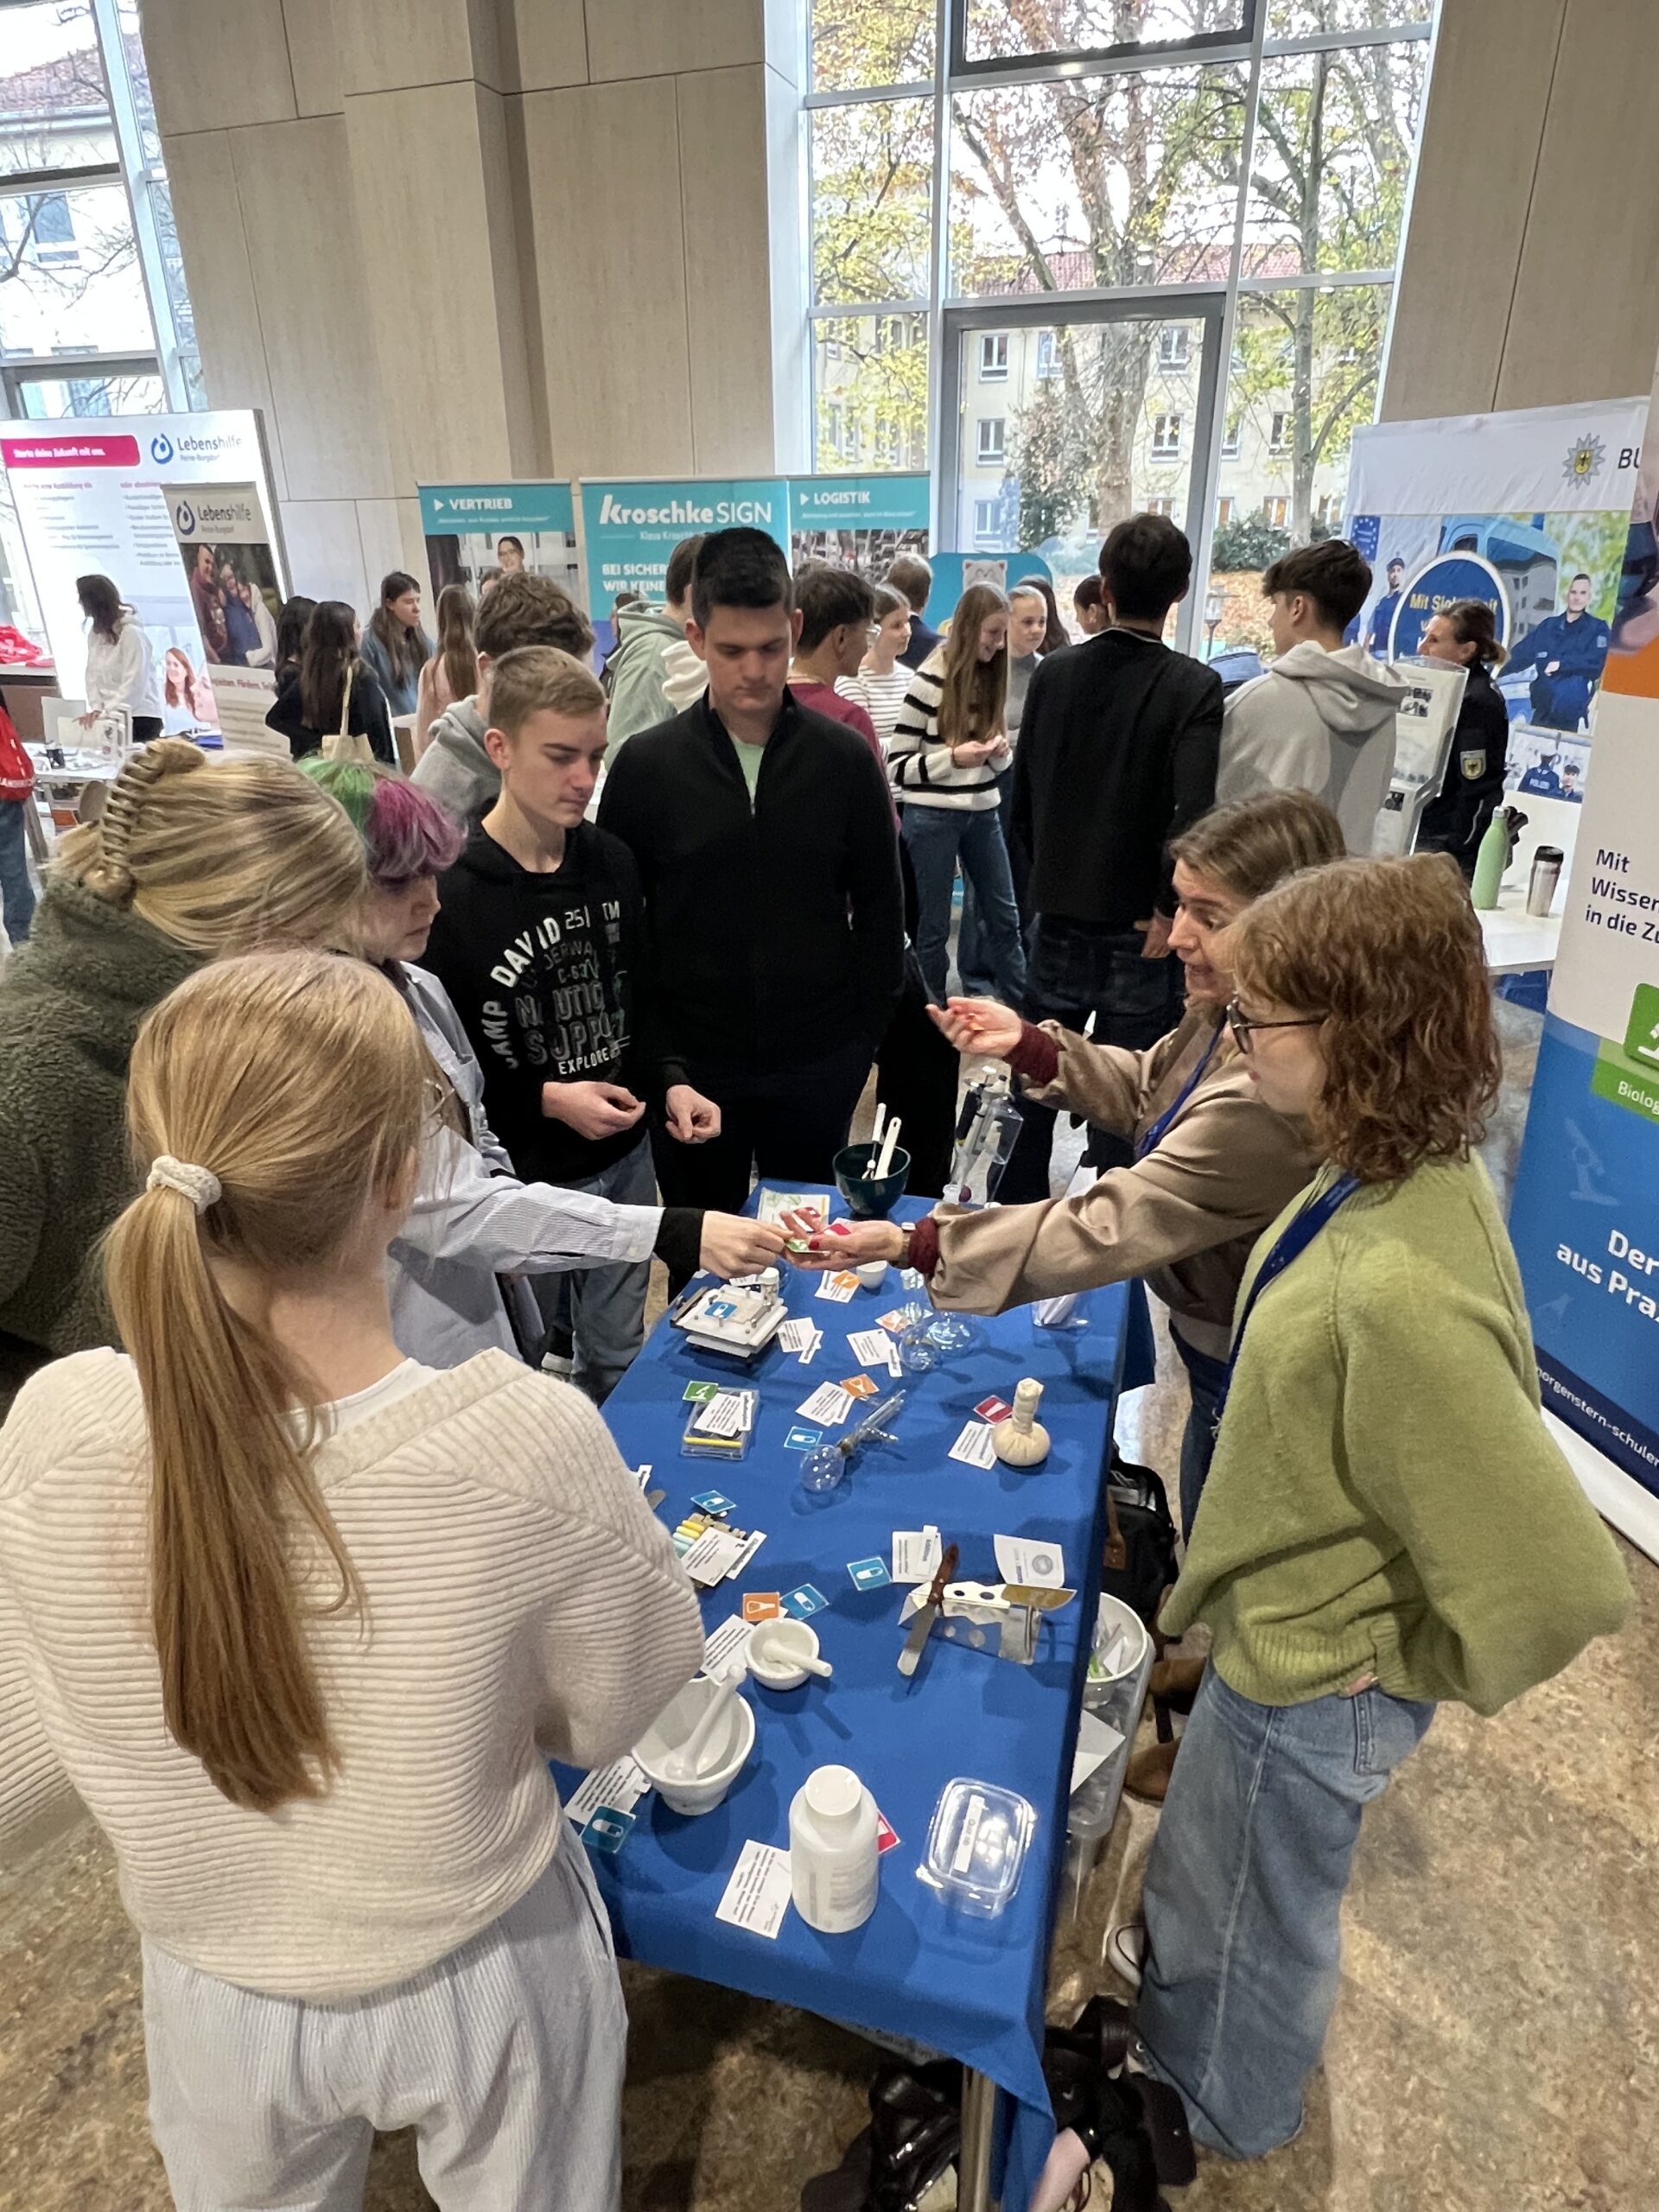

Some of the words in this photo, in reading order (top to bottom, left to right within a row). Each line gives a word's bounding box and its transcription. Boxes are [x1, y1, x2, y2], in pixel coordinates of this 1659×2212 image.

[177, 435, 242, 451] Lebenshilfe
[448, 498, 512, 511] VERTRIEB
[814, 491, 871, 505] LOGISTIK
[197, 504, 251, 521] Lebenshilfe
[602, 563, 620, 576] BEI
[603, 581, 627, 592] WIR
[1409, 594, 1429, 610] Mit
[1596, 849, 1630, 874] Mit
[1585, 904, 1602, 925] in
[1607, 912, 1637, 936] die
[490, 917, 561, 988] DAVID
[1608, 1230, 1659, 1276] Der
[1556, 1243, 1603, 1285] aus
[1608, 1270, 1659, 1323] Pra
